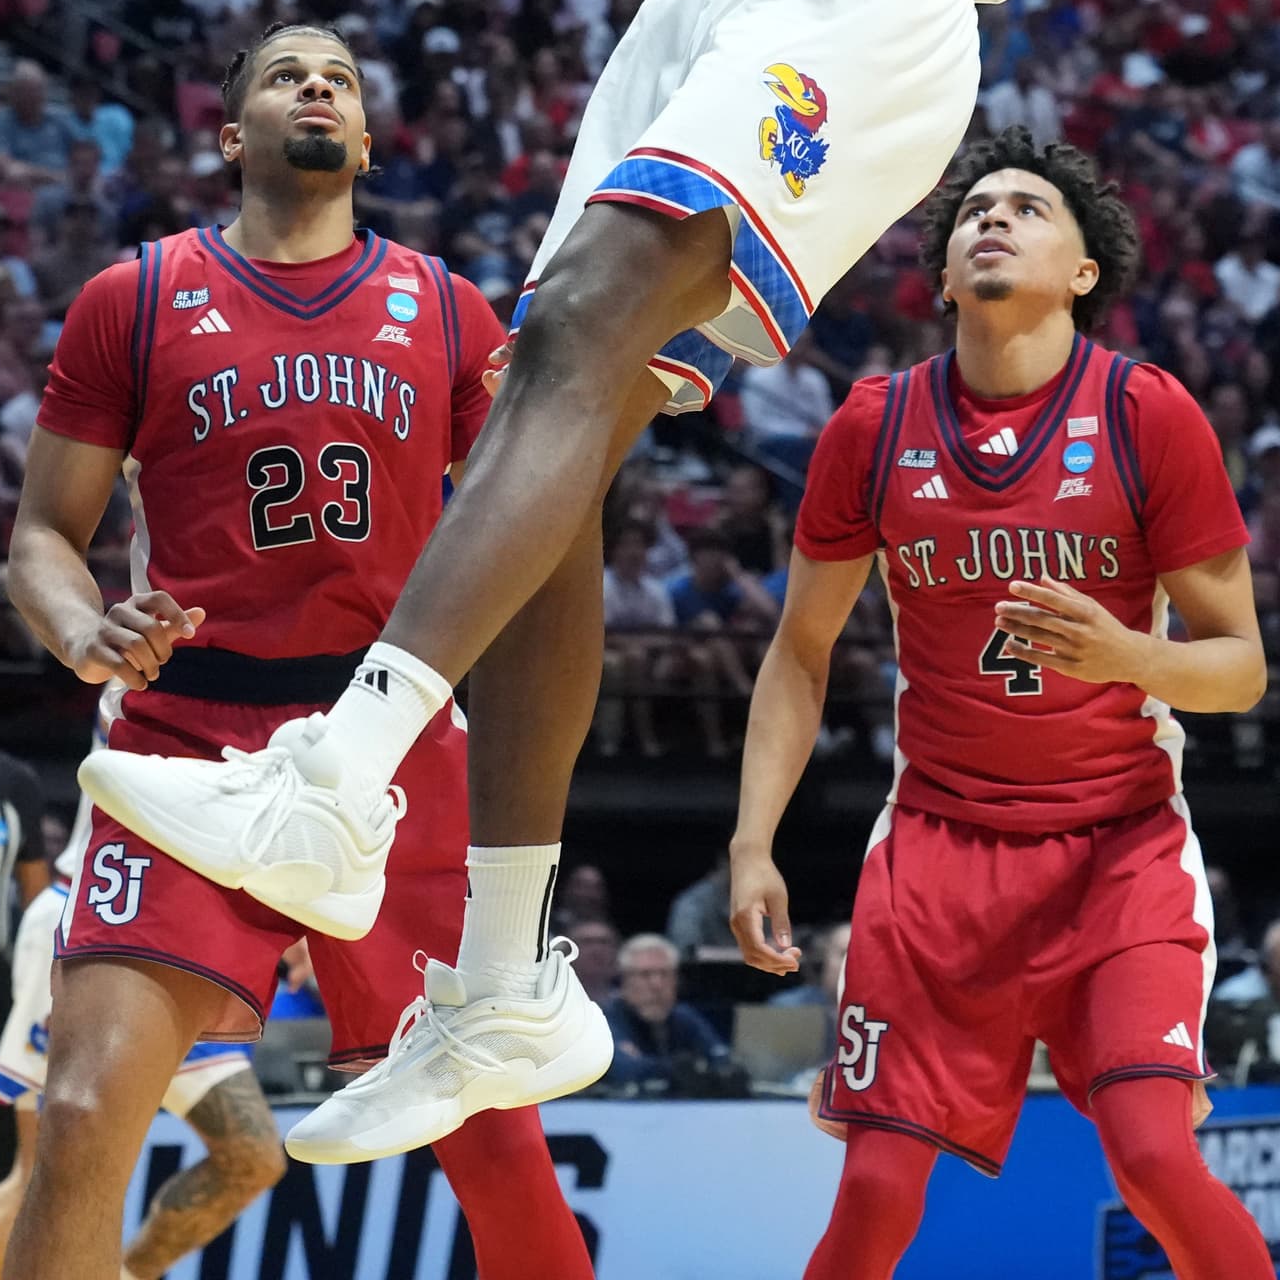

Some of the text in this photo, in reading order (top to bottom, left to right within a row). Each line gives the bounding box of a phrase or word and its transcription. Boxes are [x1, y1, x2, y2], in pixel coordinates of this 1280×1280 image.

[786, 130, 810, 159] KU
[176, 287, 209, 300] BE THE
[172, 297, 209, 309] CHANGE
[389, 303, 416, 317] NCAA
[381, 324, 408, 335] BIG
[376, 331, 413, 346] EAST
[187, 352, 417, 442] ST. JOHN'S
[904, 449, 937, 459] BE THE
[1068, 456, 1093, 465] NCAA
[898, 458, 937, 468] CHANGE
[1061, 477, 1086, 487] BIG
[246, 442, 372, 552] 23
[897, 527, 1120, 589] ST. JOHN'S
[978, 601, 1056, 696] 4
